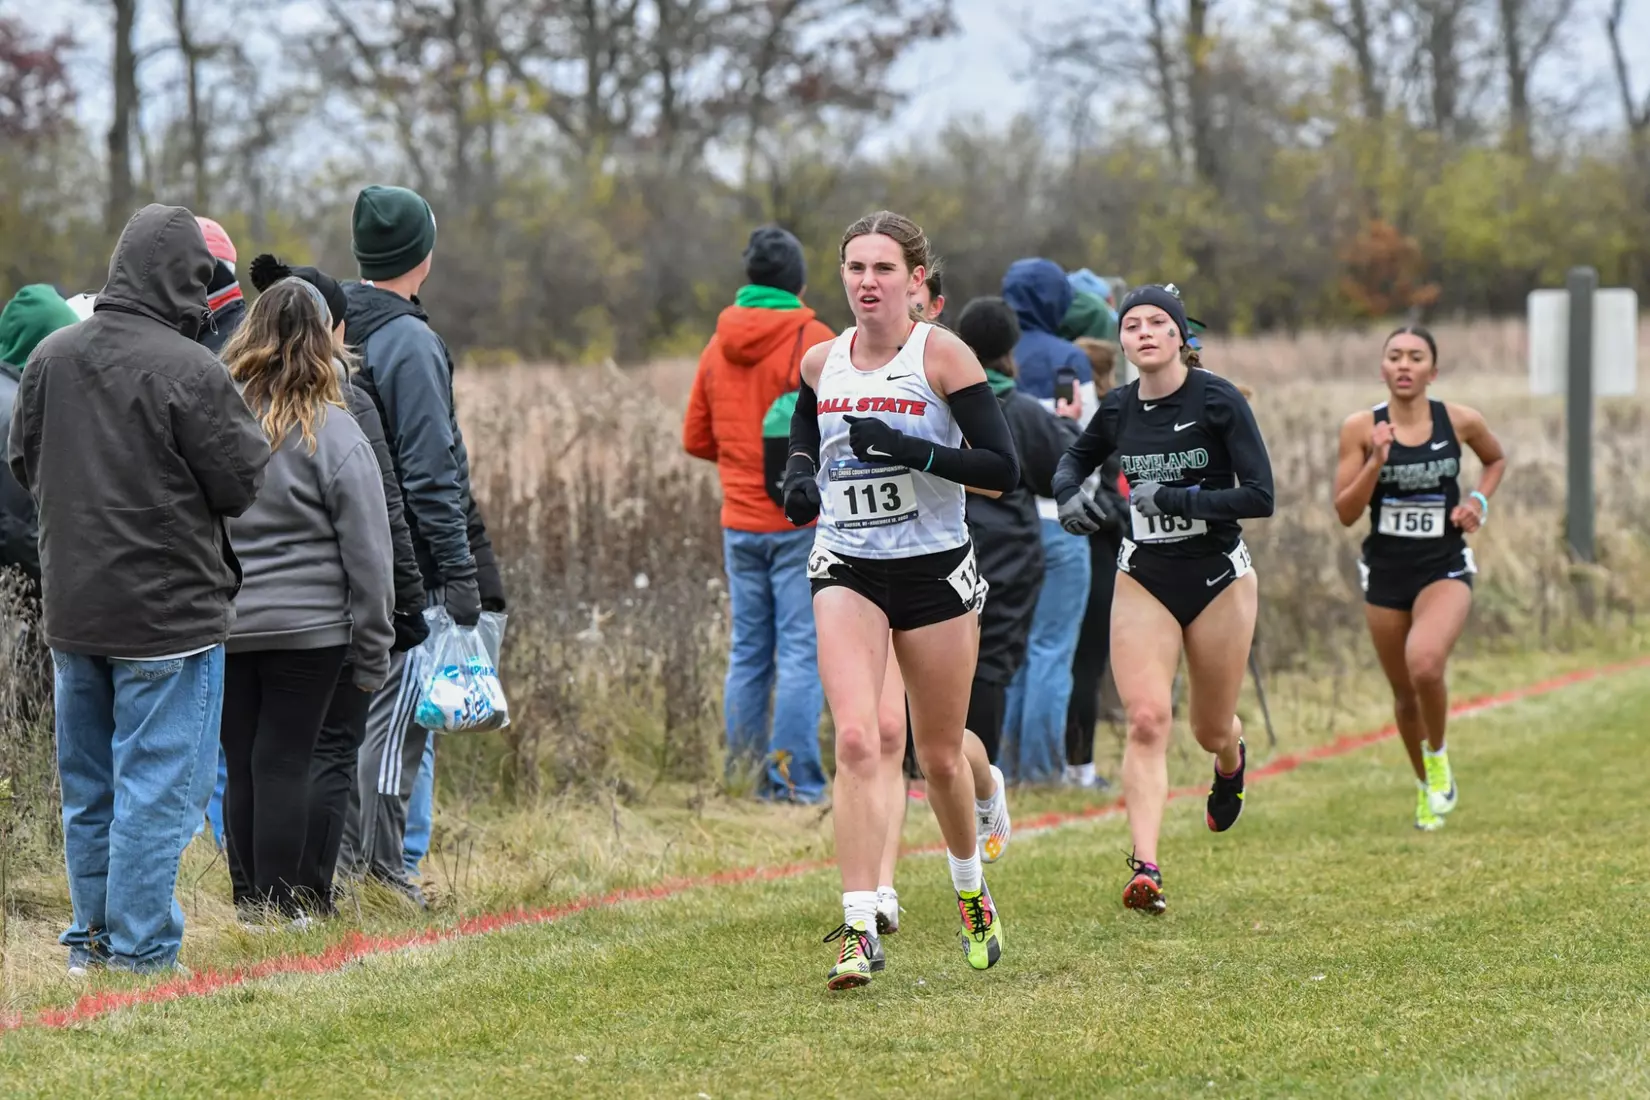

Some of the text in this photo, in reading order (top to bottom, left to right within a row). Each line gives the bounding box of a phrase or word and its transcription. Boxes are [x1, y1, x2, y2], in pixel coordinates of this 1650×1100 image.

[856, 397, 927, 416] STATE
[1120, 447, 1209, 476] CLEVELAND
[843, 482, 902, 515] 113
[1391, 511, 1434, 532] 156
